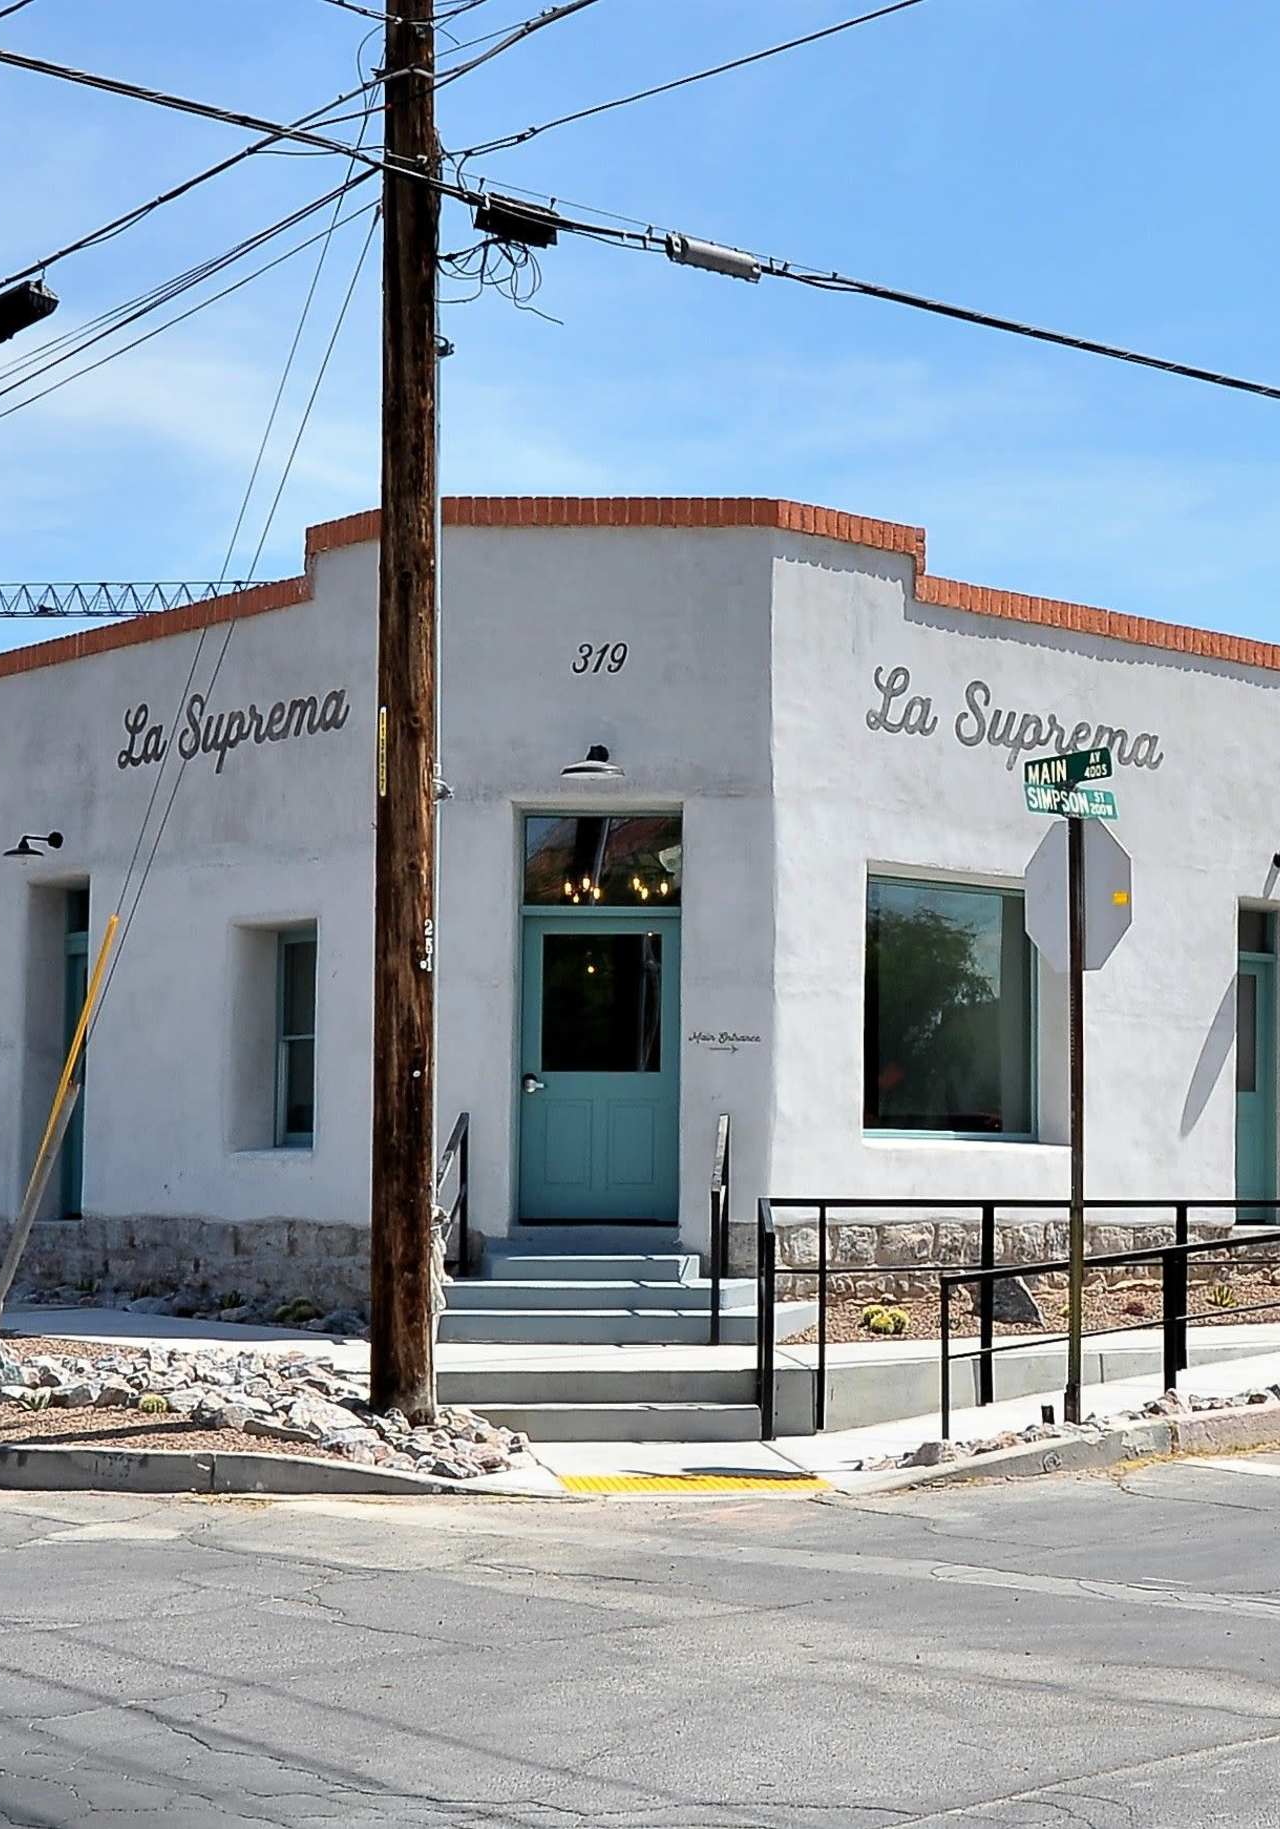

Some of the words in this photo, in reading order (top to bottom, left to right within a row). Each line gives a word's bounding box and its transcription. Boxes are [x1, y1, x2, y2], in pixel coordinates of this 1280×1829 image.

[572, 643, 628, 674] 319
[117, 703, 168, 770] La
[178, 688, 350, 774] Suprema
[866, 666, 938, 736] La
[955, 680, 1164, 770] Suprema
[1027, 758, 1067, 785] MAIN
[1083, 763, 1108, 778] 400S
[1027, 787, 1090, 814] SIMPSON
[1093, 791, 1106, 803] ST
[1089, 803, 1113, 816] 200W
